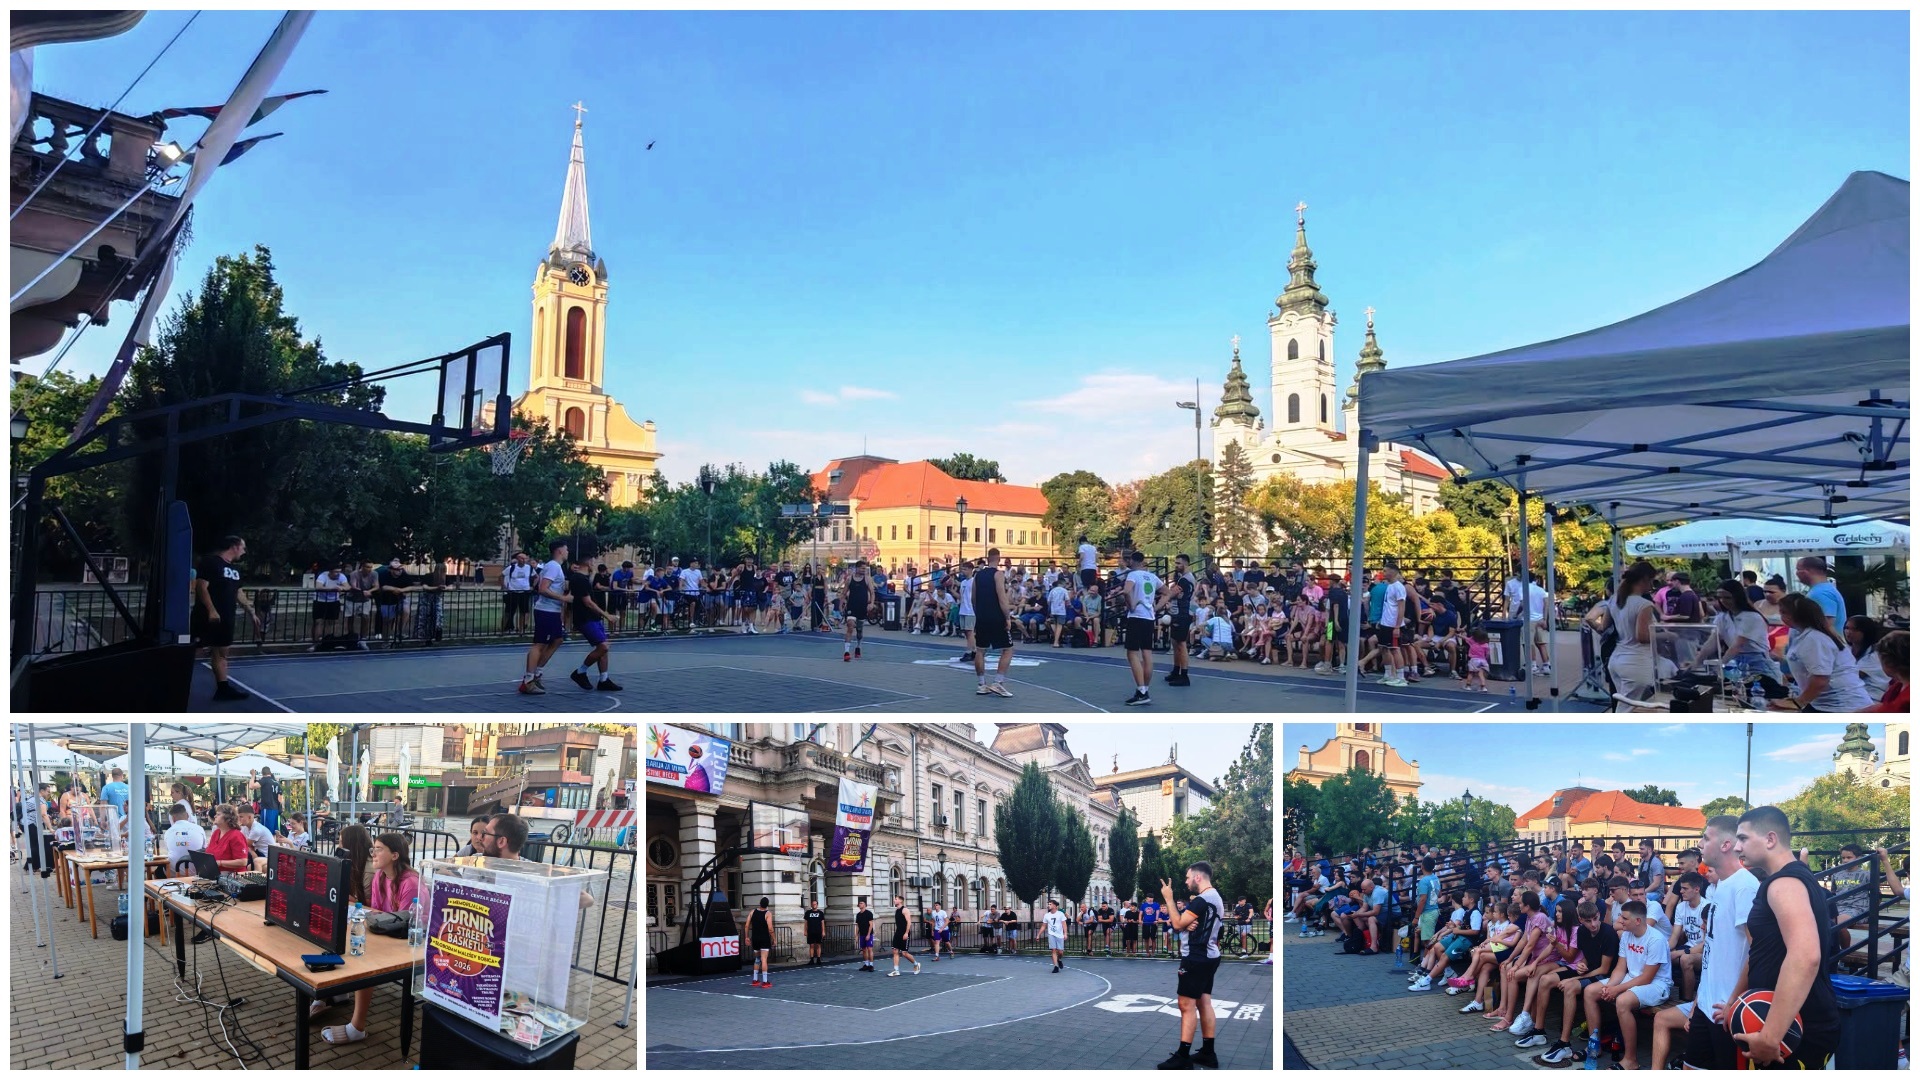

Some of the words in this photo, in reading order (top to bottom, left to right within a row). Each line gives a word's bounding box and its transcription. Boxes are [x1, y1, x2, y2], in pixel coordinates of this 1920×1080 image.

[1833, 531, 1882, 546] Carlsberg
[710, 741, 729, 792] BEČEJ
[269, 868, 274, 880] D
[329, 887, 337, 903] G
[441, 908, 495, 938] TURNIR
[1050, 917, 1057, 926] 7
[447, 924, 454, 933] U
[456, 926, 486, 943] STREET
[447, 933, 484, 952] BASKETU
[701, 937, 740, 958] mts
[453, 959, 471, 971] 2026
